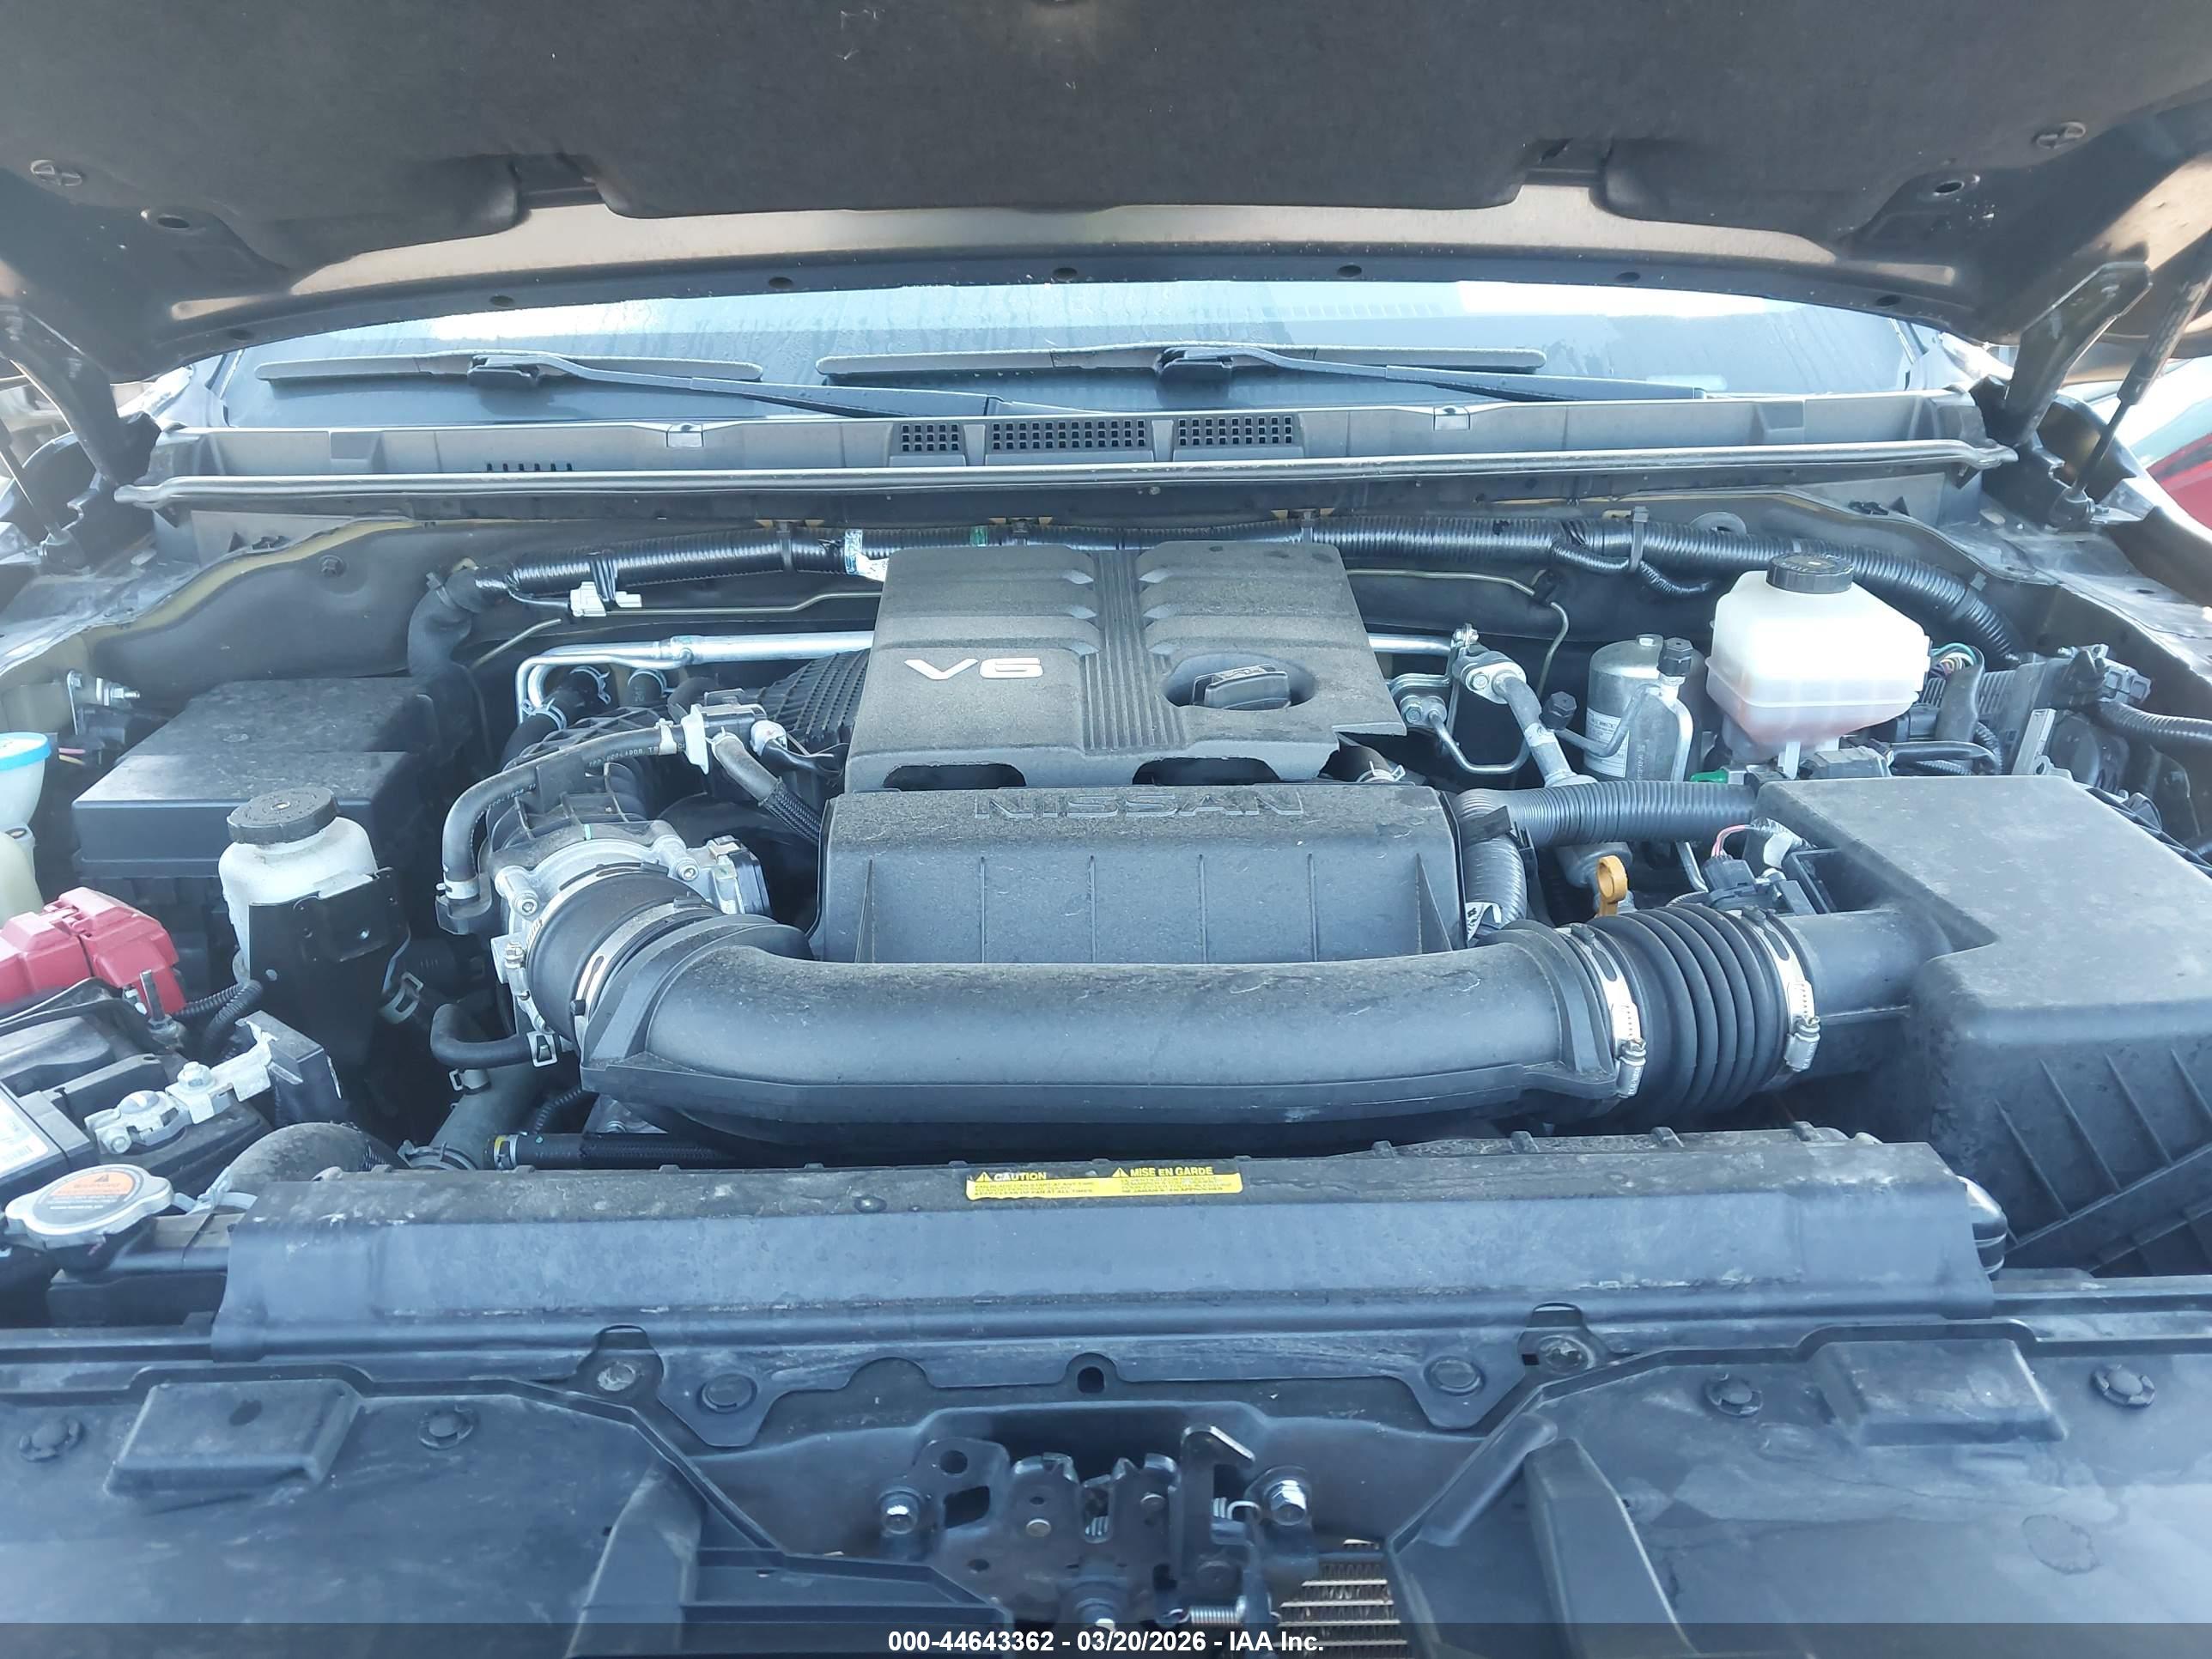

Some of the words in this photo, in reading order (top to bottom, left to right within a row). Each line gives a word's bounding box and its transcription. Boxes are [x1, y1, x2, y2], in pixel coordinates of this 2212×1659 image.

[904, 658, 1043, 680] V6
[975, 791, 1304, 818] NISSAN
[994, 1171, 1047, 1182] CAUTION
[1130, 1167, 1156, 1177] MISE
[1158, 1168, 1174, 1176] EN
[1175, 1166, 1214, 1176] GARDE
